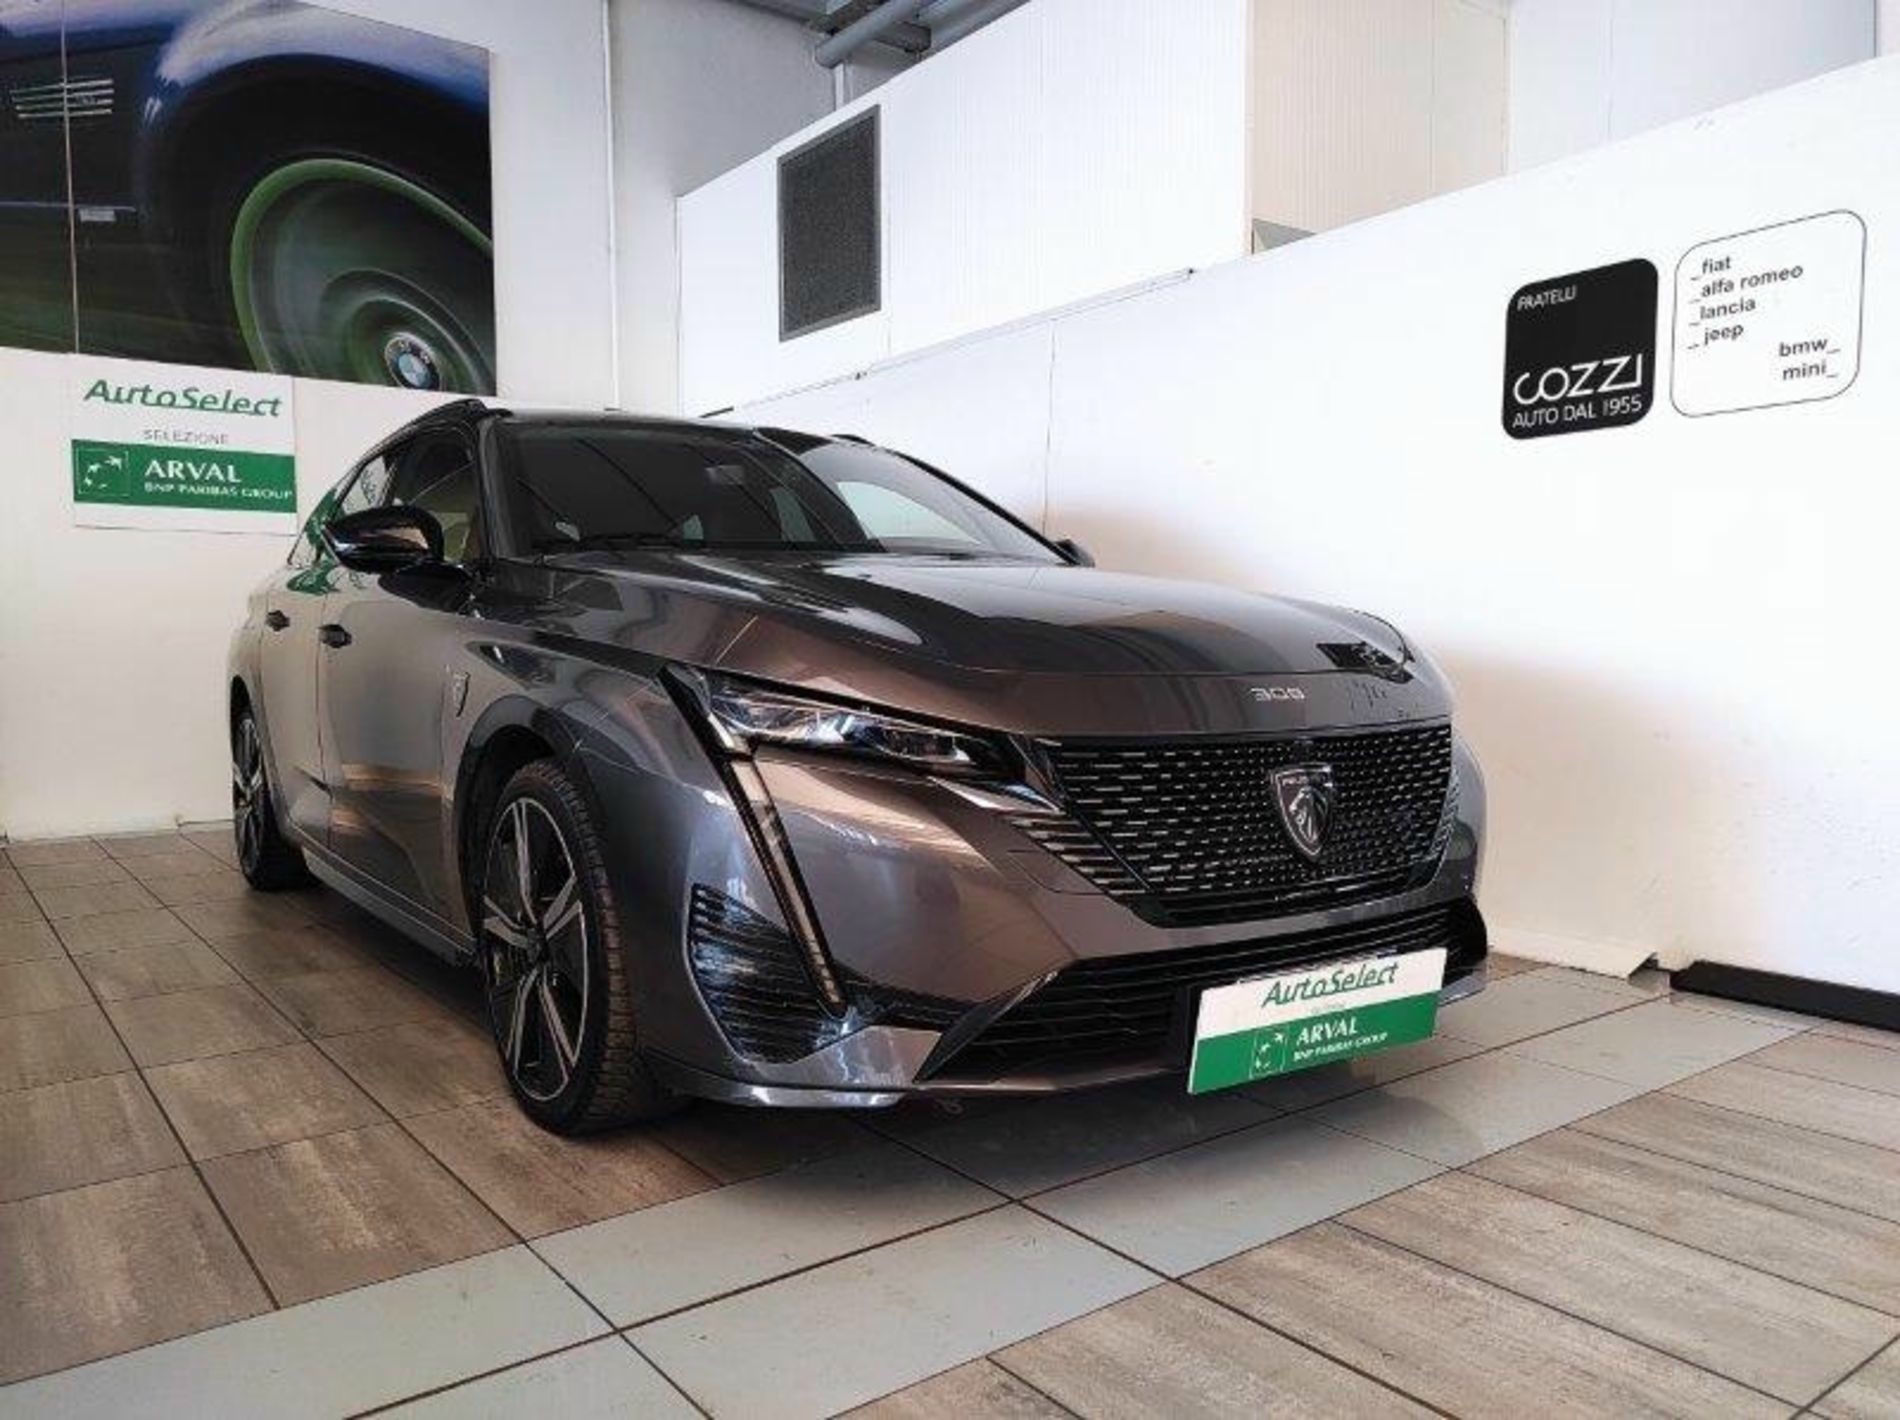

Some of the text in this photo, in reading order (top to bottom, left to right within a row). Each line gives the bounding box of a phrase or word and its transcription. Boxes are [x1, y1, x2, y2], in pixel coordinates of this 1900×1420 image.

[1740, 265, 1804, 289] romeo
[1513, 353, 1643, 405] COZZI
[83, 379, 282, 417] AutoSelect
[1512, 394, 1643, 428] AUTO DAL 1955
[143, 429, 229, 444] SELEZIONE
[144, 459, 242, 483] ARVAL
[144, 482, 174, 493] BNP
[241, 488, 293, 500] GROUP
[1262, 961, 1399, 1008] AutoSelect
[1296, 1016, 1358, 1046] ARVAL
